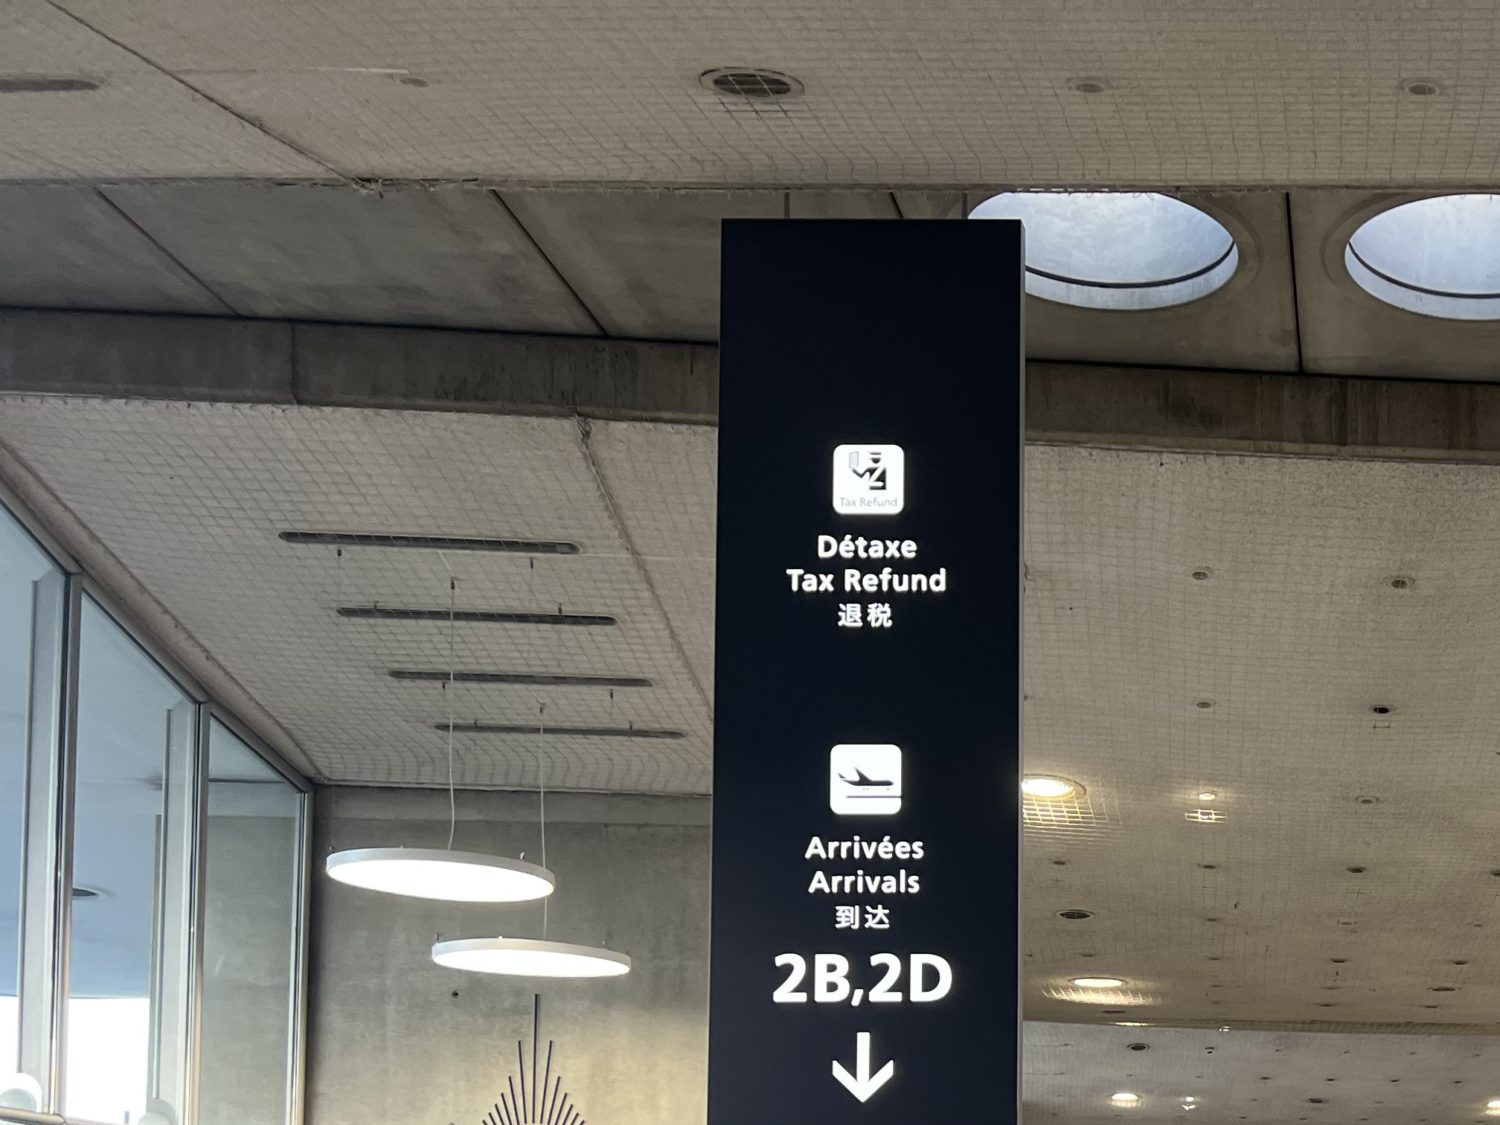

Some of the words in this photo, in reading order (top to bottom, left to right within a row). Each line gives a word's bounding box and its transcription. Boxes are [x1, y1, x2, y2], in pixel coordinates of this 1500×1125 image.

[839, 497, 857, 507] Tax
[859, 497, 898, 507] Refund
[817, 534, 918, 559] Détaxe
[786, 568, 835, 592] Tax
[844, 567, 947, 592] Refund
[837, 603, 893, 628] 退税
[804, 836, 925, 860] Arrivées
[808, 869, 920, 894] Arrivals
[834, 905, 890, 929] 到达
[772, 953, 953, 1006] 2B,2D
